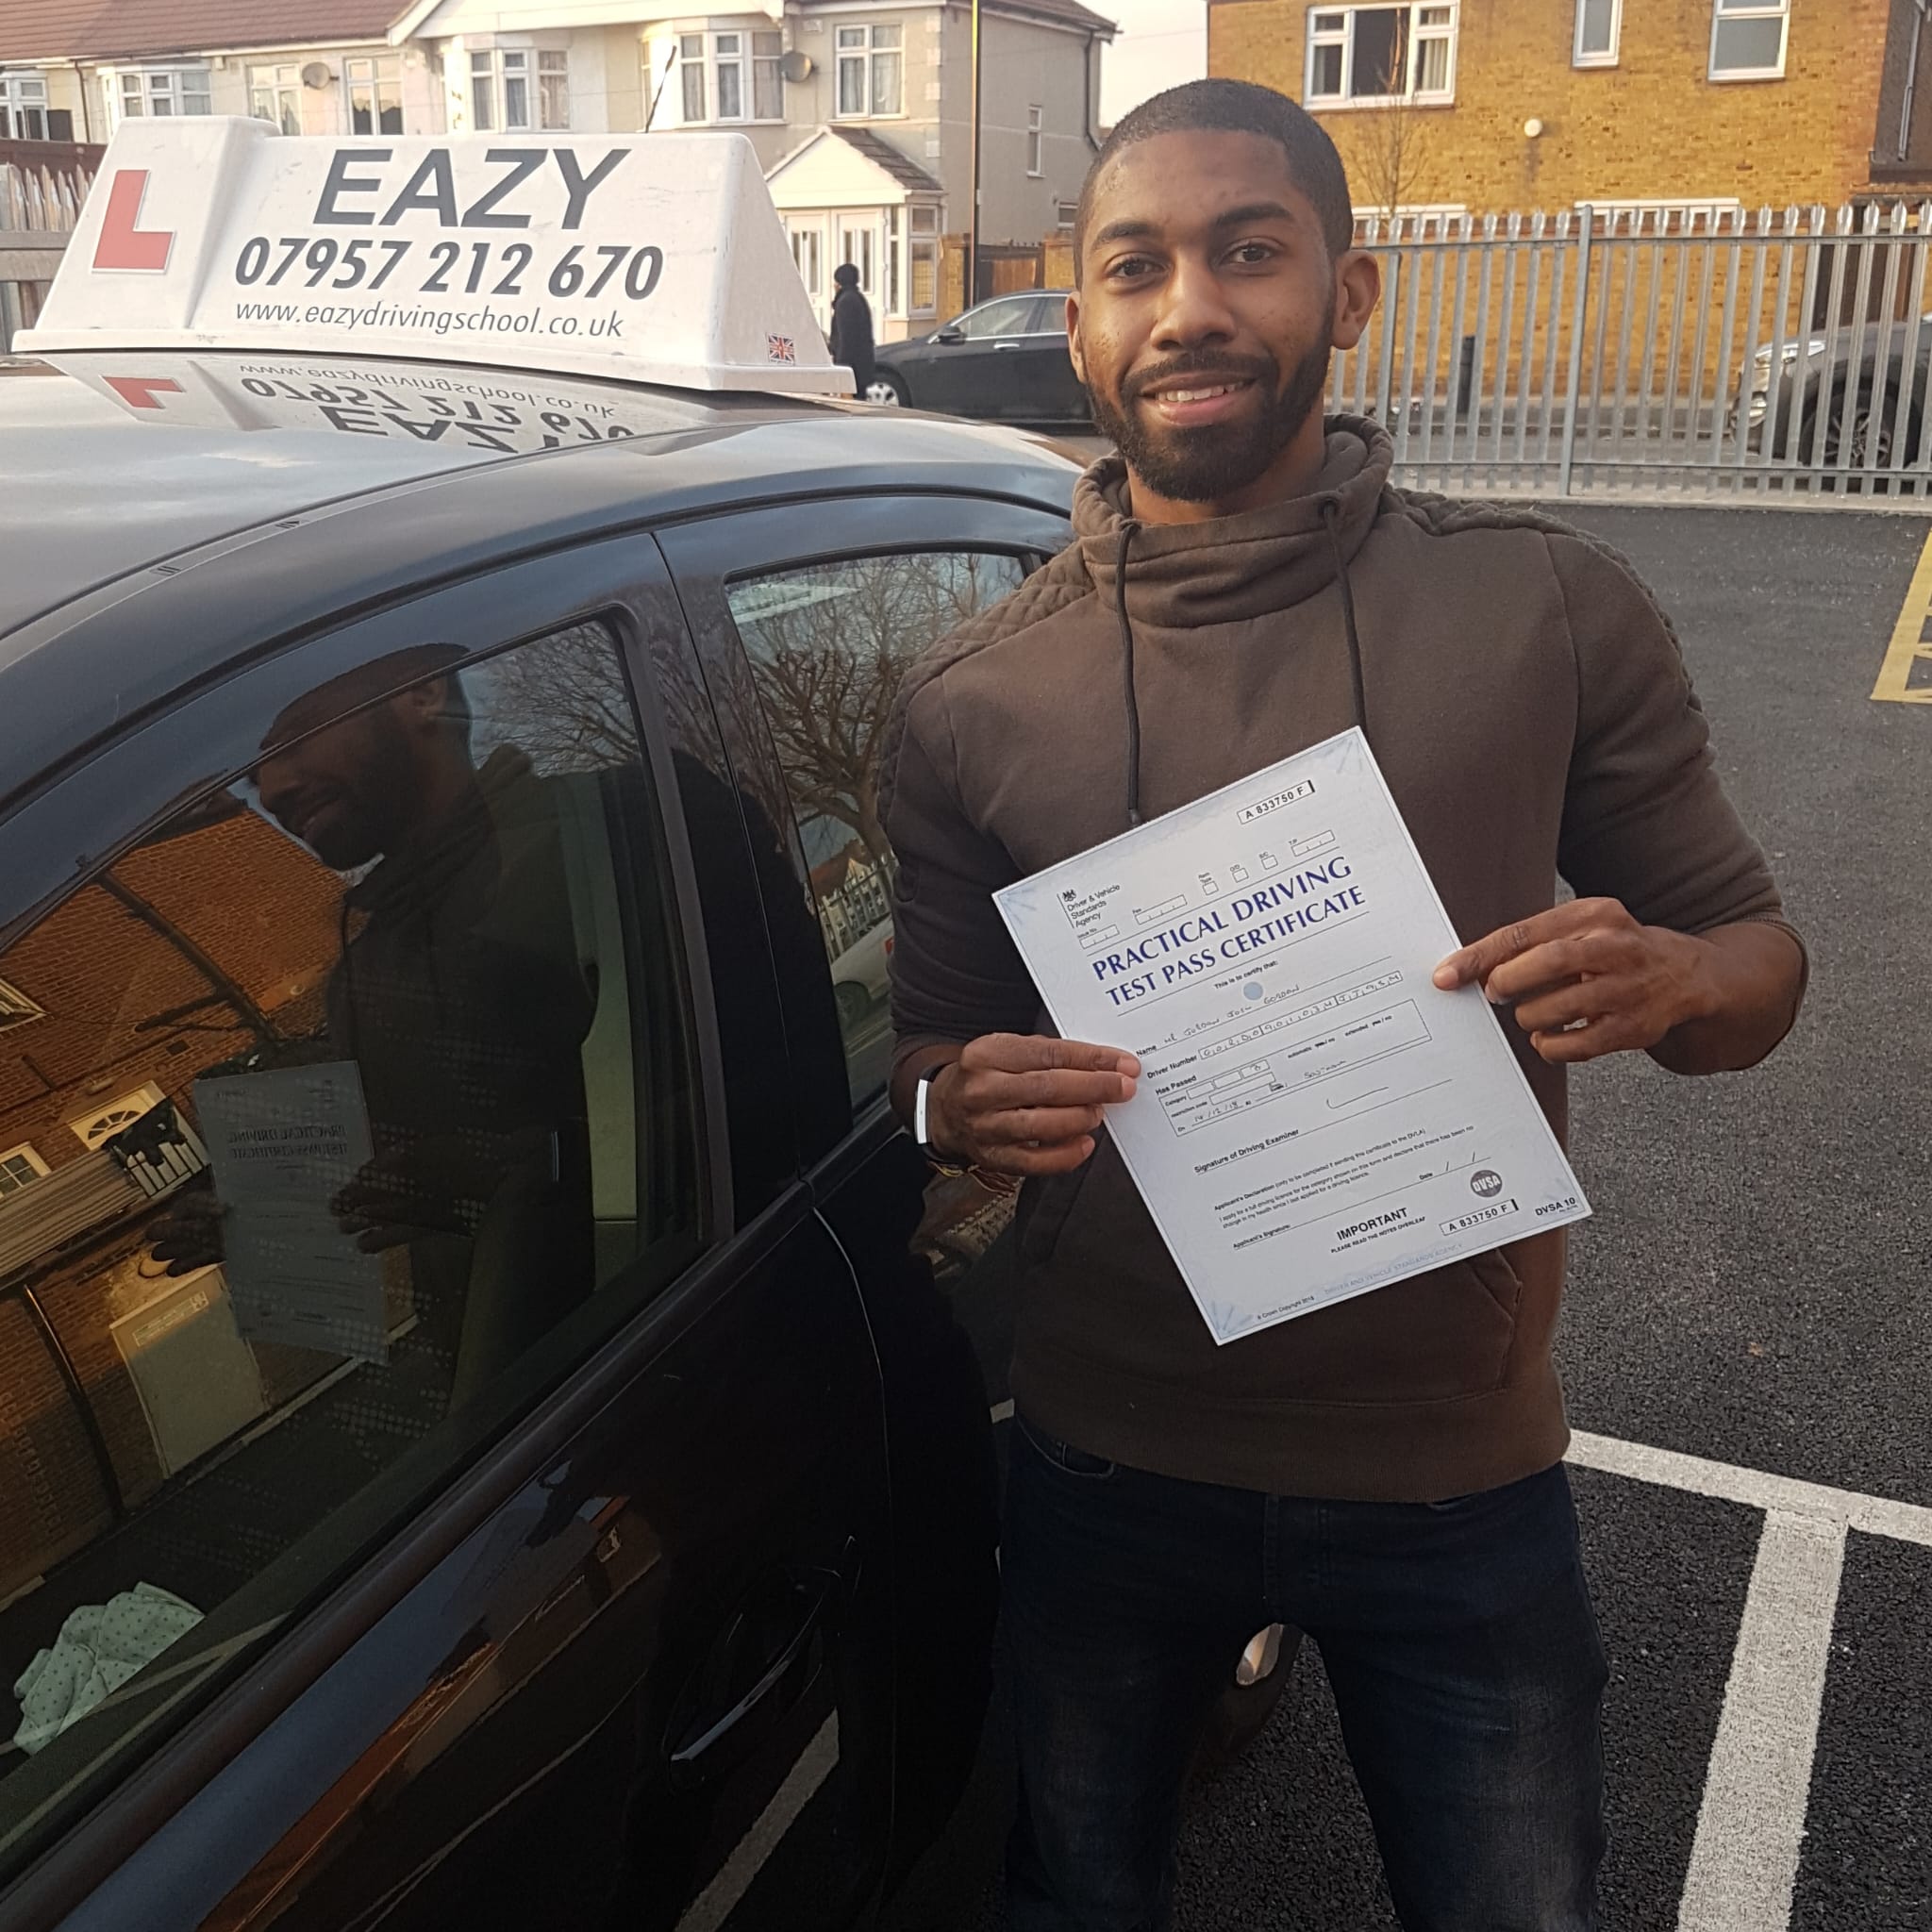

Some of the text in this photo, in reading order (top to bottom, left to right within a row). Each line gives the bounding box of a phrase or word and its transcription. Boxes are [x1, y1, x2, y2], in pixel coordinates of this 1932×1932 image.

[313, 147, 632, 230] EAZY
[93, 169, 174, 270] L
[236, 237, 663, 301] 07957 212 670
[236, 300, 624, 338] www.eazydrivingschool.co.uk
[1243, 786, 1305, 820] A 833750 F
[1074, 910, 1102, 929] Agency
[1091, 854, 1352, 982] PRACTICAL DRIVING
[1105, 884, 1366, 1008] TEST PASS CERTIFICATE
[1135, 1043, 1158, 1057] Name
[1146, 1053, 1198, 1079] Driver Number
[1155, 1074, 1197, 1095] Has Passed
[1192, 1126, 1300, 1174] Signature of Driving Examiner
[1418, 1171, 1434, 1181] Date
[1471, 1173, 1501, 1193] DVSA
[1446, 1203, 1509, 1231] A 833750 F
[1534, 1200, 1563, 1216] DVSA
[1563, 1195, 1576, 1206] 10
[1335, 1207, 1409, 1241] IMPORTANT
